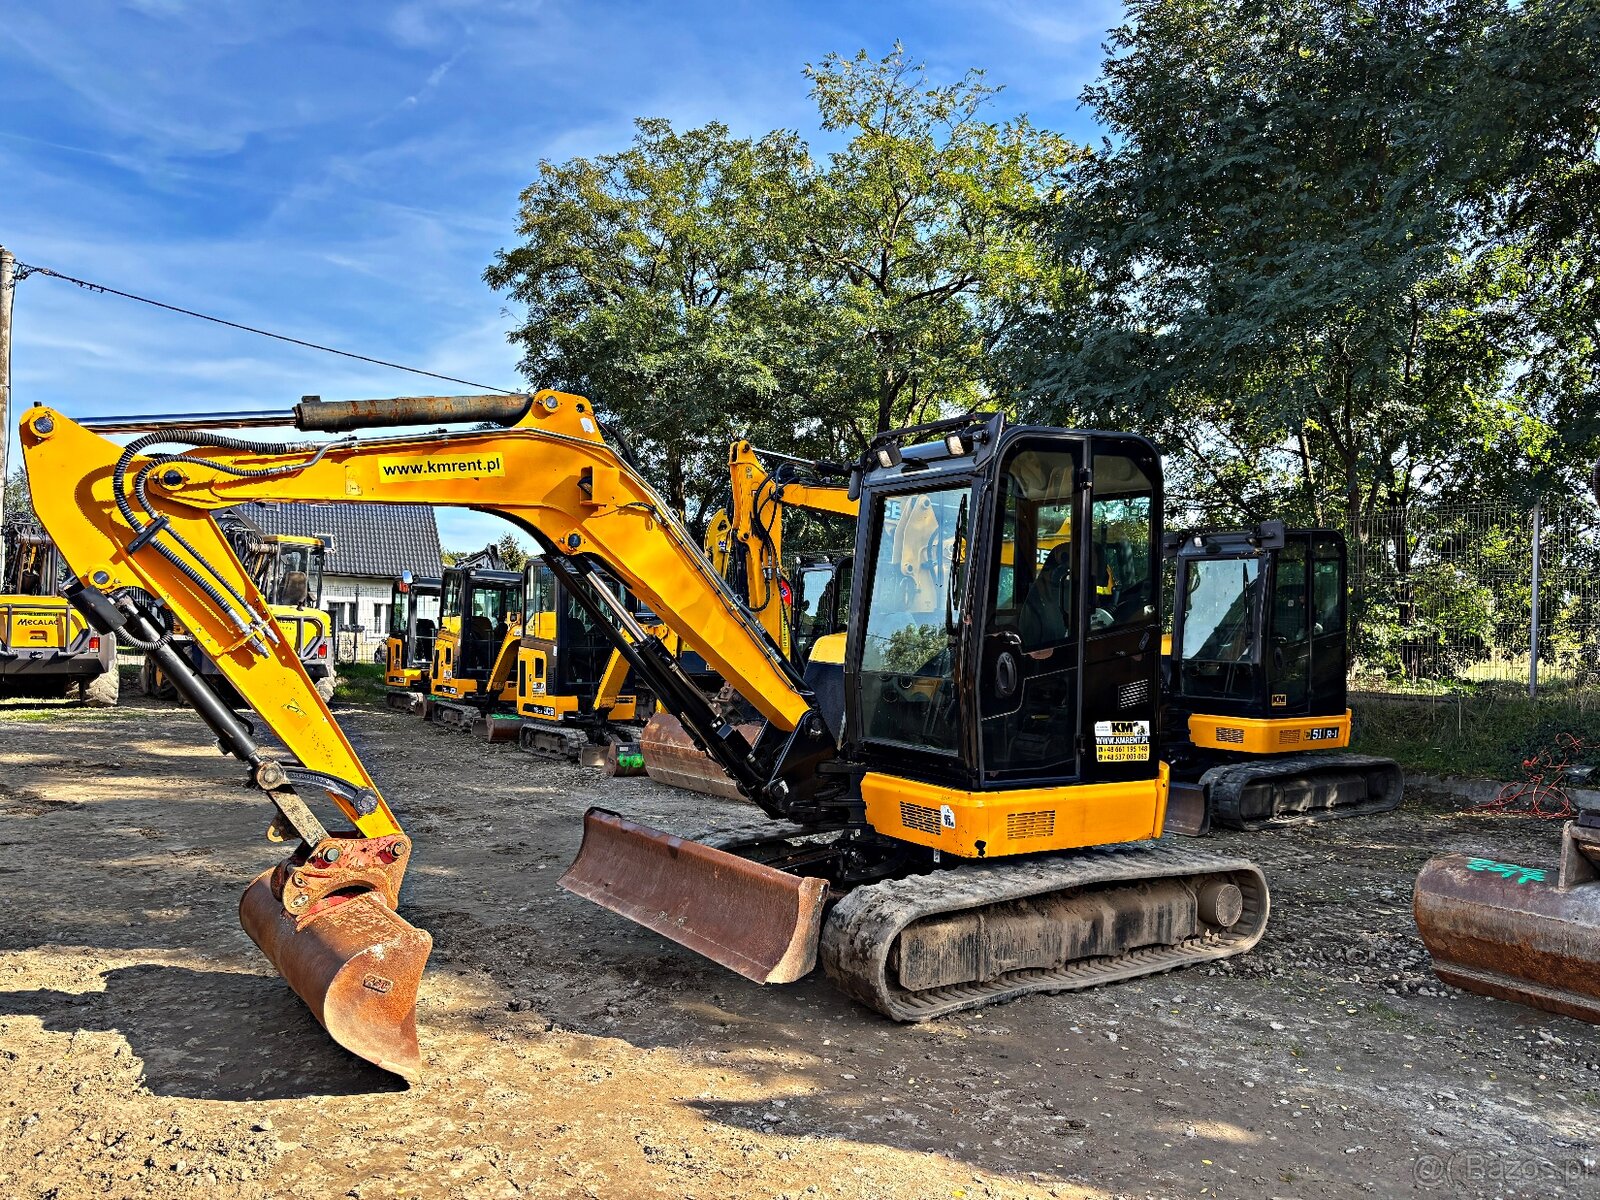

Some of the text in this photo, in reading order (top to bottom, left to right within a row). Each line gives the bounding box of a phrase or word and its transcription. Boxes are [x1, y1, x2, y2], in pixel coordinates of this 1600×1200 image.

[383, 457, 500, 476] www.kmrent.pl
[1111, 722, 1133, 732] KM
[1095, 736, 1150, 744] WWW.KMRENT.PL
